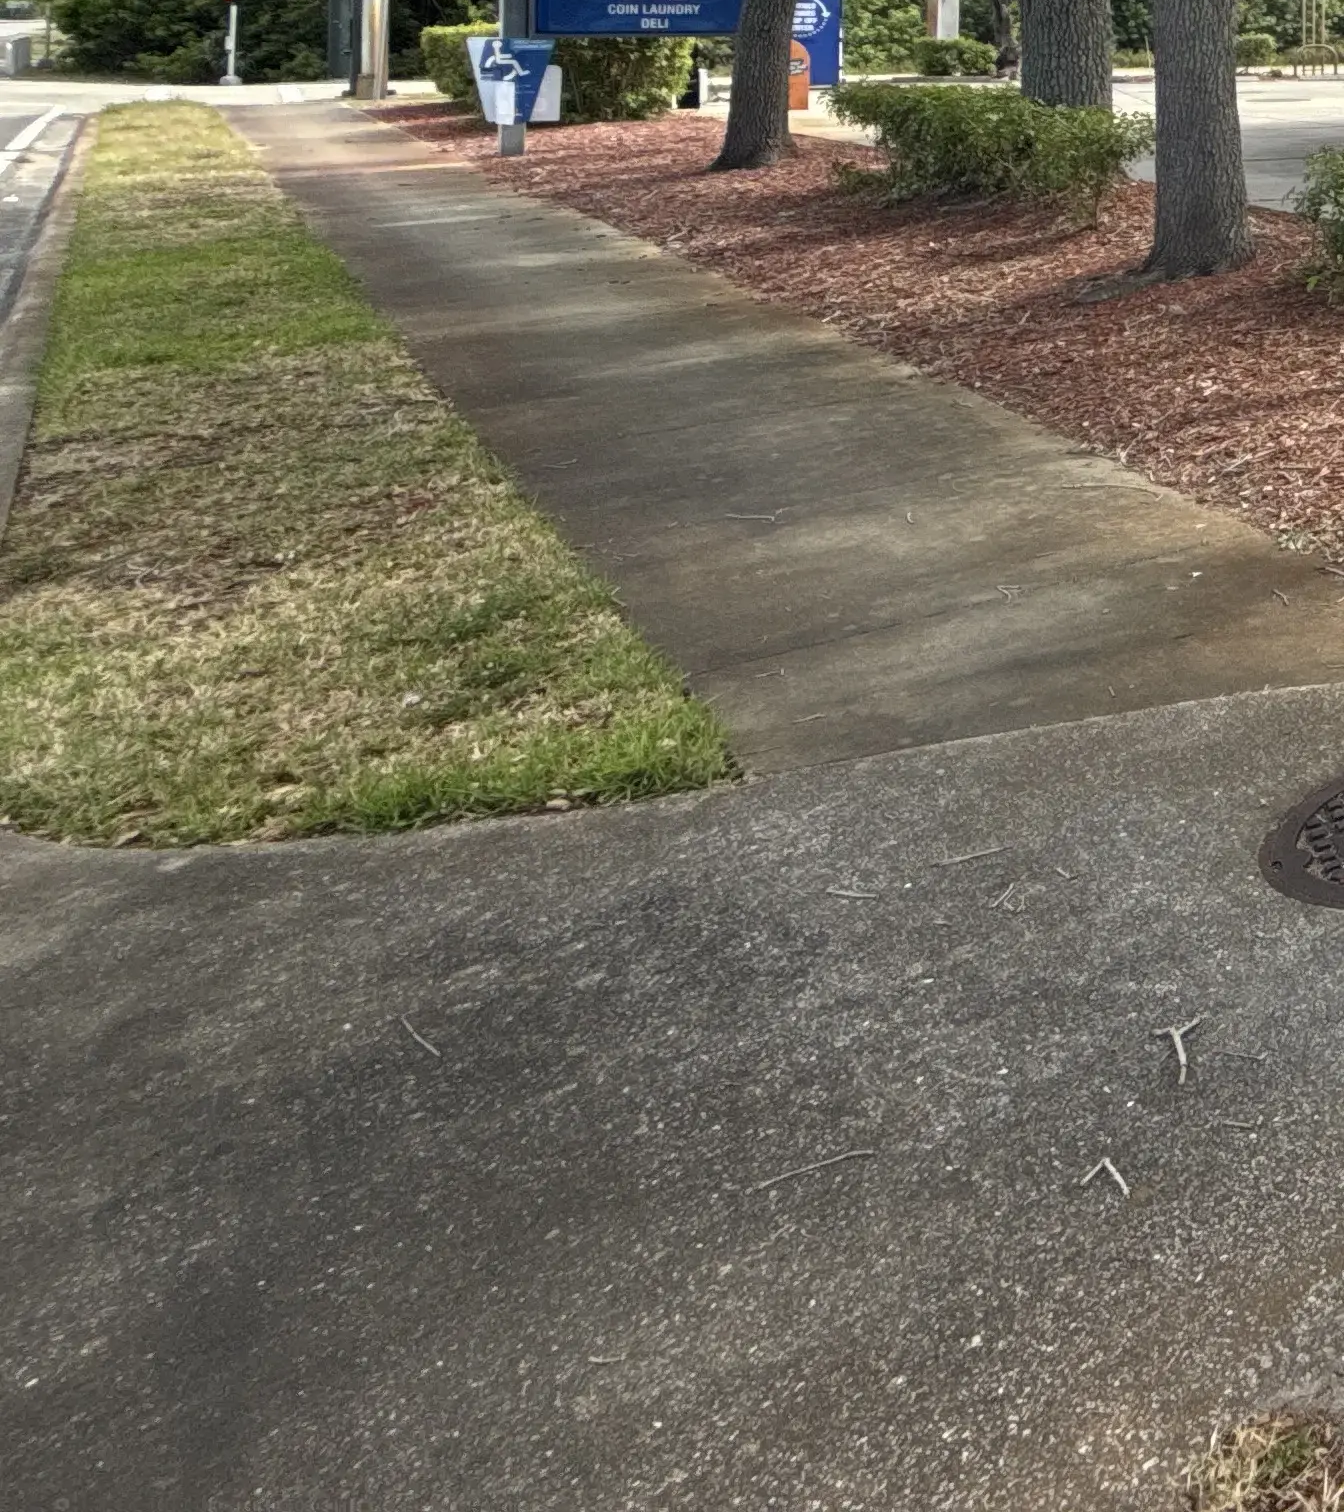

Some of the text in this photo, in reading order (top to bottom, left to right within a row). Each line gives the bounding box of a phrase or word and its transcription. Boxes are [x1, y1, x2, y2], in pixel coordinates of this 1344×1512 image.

[608, 4, 701, 15] COIN LAUNDRY
[640, 18, 669, 29] DELI
